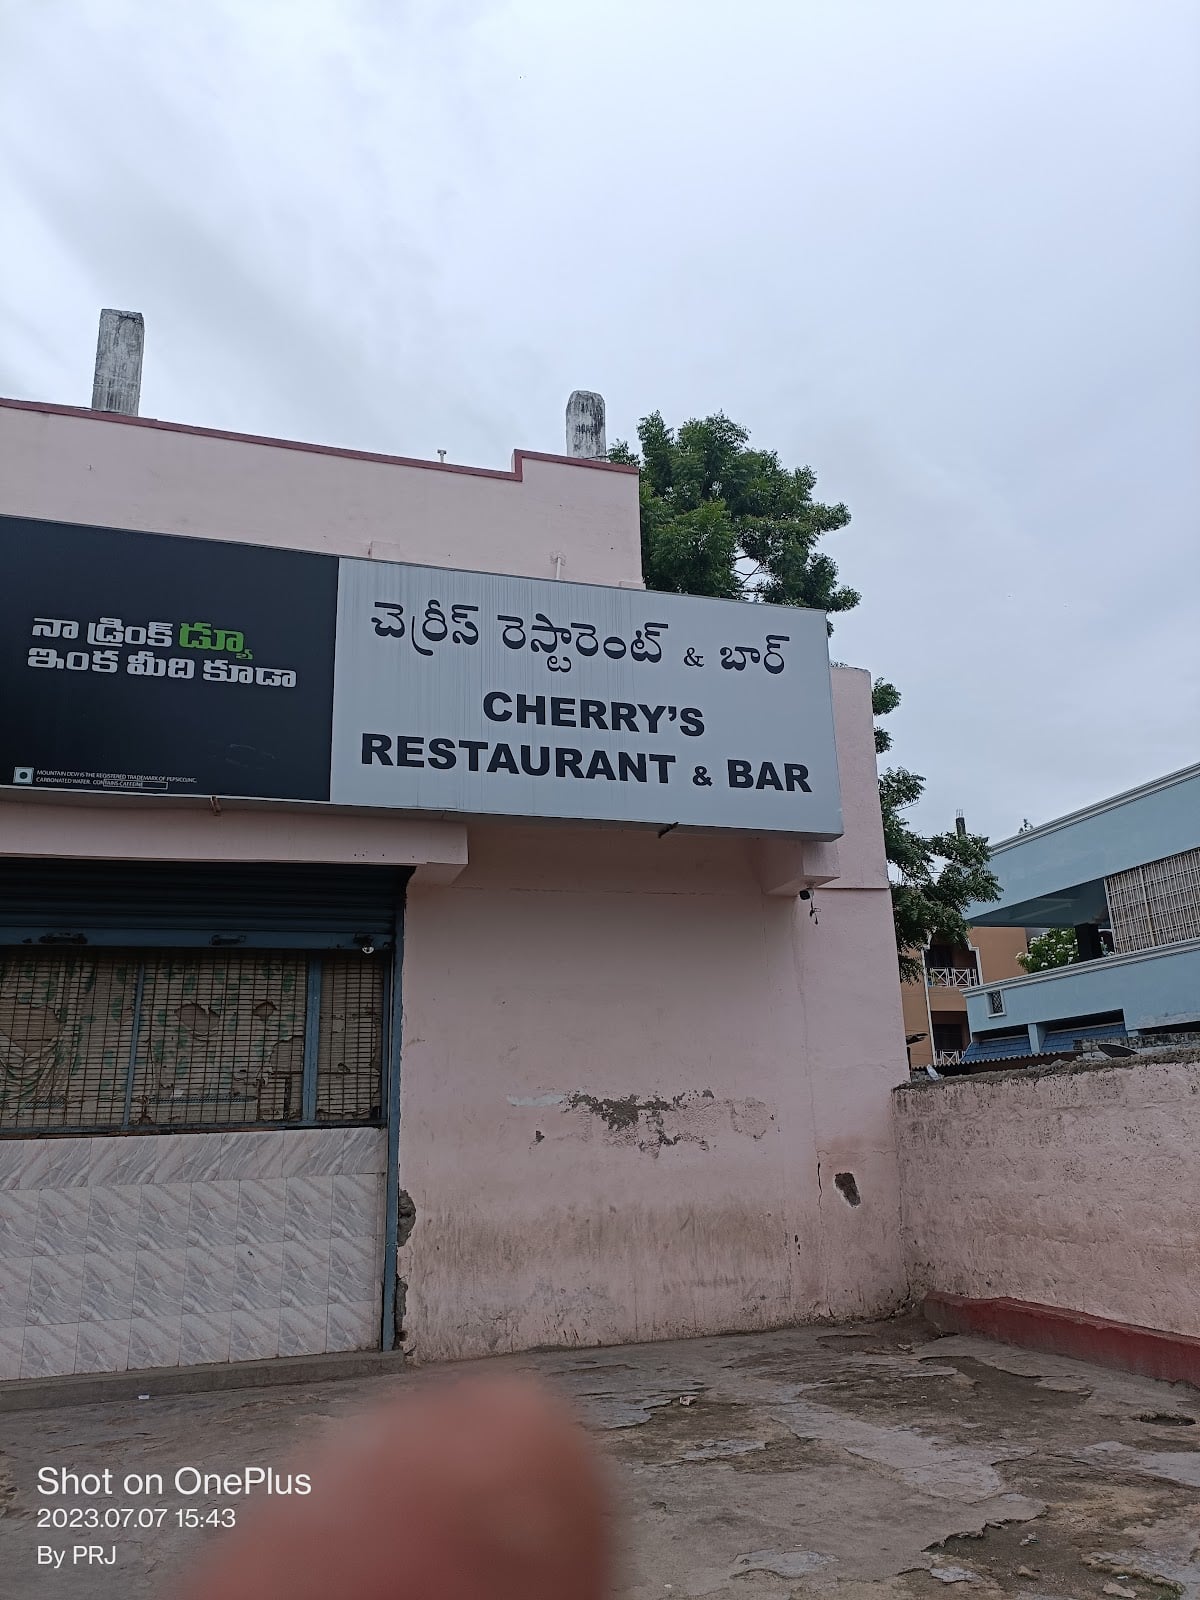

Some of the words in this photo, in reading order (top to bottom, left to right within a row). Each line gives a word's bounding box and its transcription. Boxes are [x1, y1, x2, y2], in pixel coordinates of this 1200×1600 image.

[32, 617, 80, 639] నా
[86, 616, 174, 648] డ్రింక్
[370, 599, 480, 656] చెర్రీస్
[497, 612, 669, 673] రెస్టారెంట్
[683, 647, 704, 668] &
[719, 634, 790, 675] బార్
[27, 647, 119, 673] ఇంక
[126, 650, 195, 679] మీది
[202, 659, 297, 688] కూడా
[361, 733, 677, 785] RESTAURANT
[692, 765, 713, 788] &
[727, 759, 813, 794] BAR
